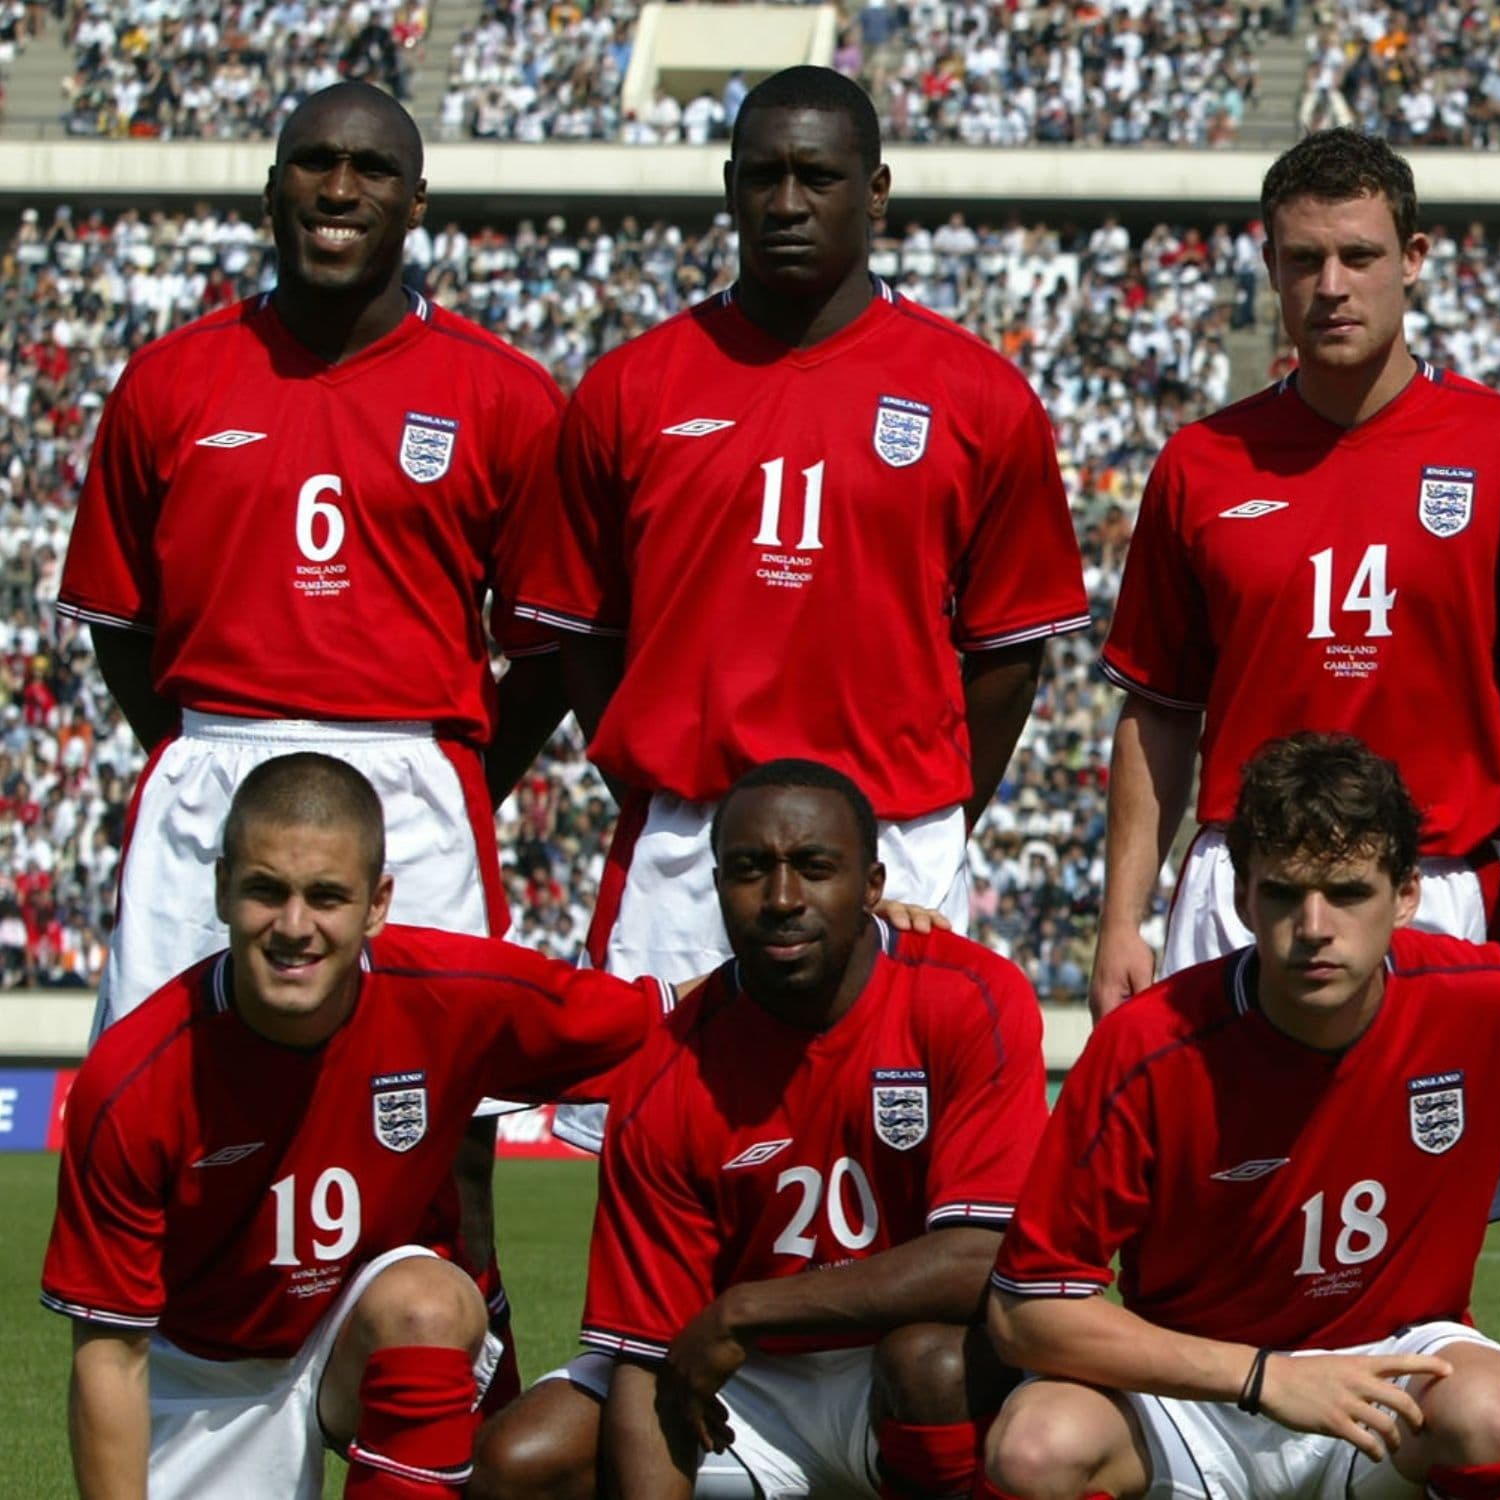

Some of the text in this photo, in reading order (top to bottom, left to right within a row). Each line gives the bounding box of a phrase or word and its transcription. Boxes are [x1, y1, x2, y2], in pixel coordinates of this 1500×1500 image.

[1426, 467, 1474, 479] ENGLAND
[752, 456, 825, 550] 11
[296, 473, 345, 562] 6
[760, 552, 813, 567] ENGLAND
[296, 564, 347, 575] ENGLAND
[1307, 544, 1398, 639] 14
[1325, 644, 1378, 655] ENGLAND
[374, 1072, 422, 1086] ENGLAND
[875, 1070, 925, 1079] ENGLAND
[1411, 1072, 1460, 1089] ENGLAND
[270, 1166, 361, 1266] 19
[772, 1156, 879, 1259] 20
[1294, 1179, 1388, 1276] 18
